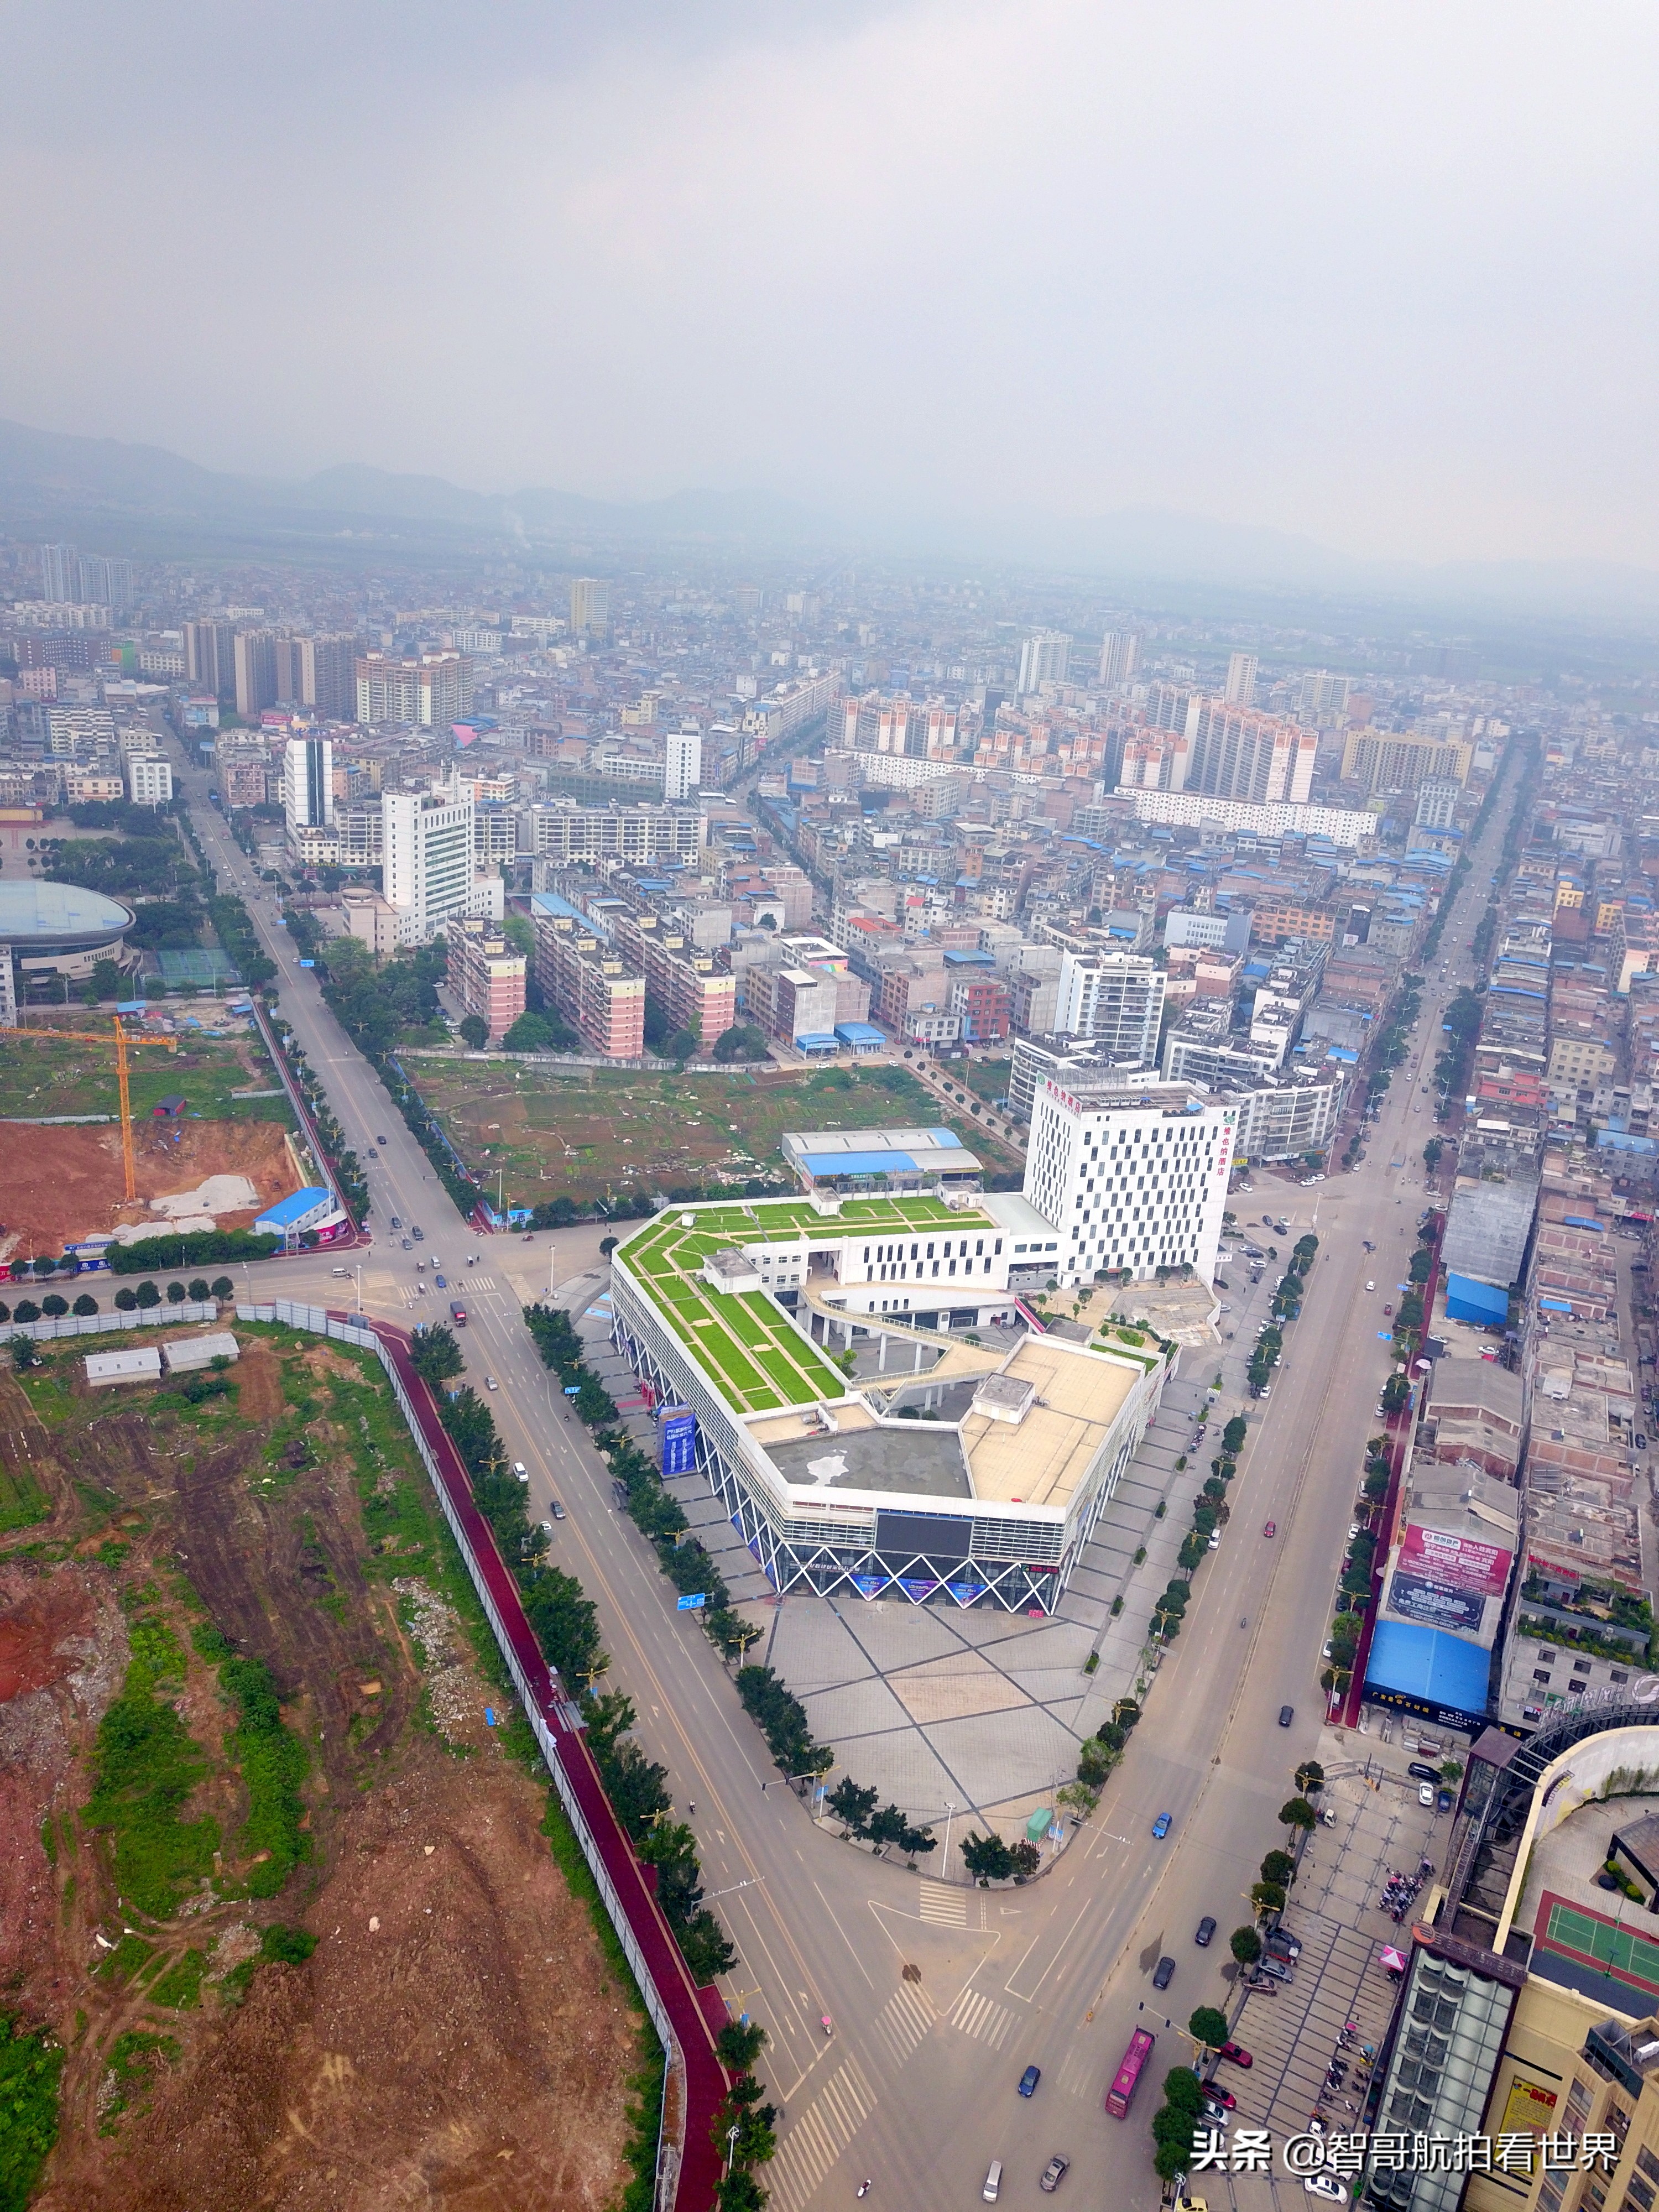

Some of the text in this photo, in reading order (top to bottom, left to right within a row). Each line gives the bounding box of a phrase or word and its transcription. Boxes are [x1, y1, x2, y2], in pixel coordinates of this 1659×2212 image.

[1217, 1126, 1232, 1176] 维也纳酒店
